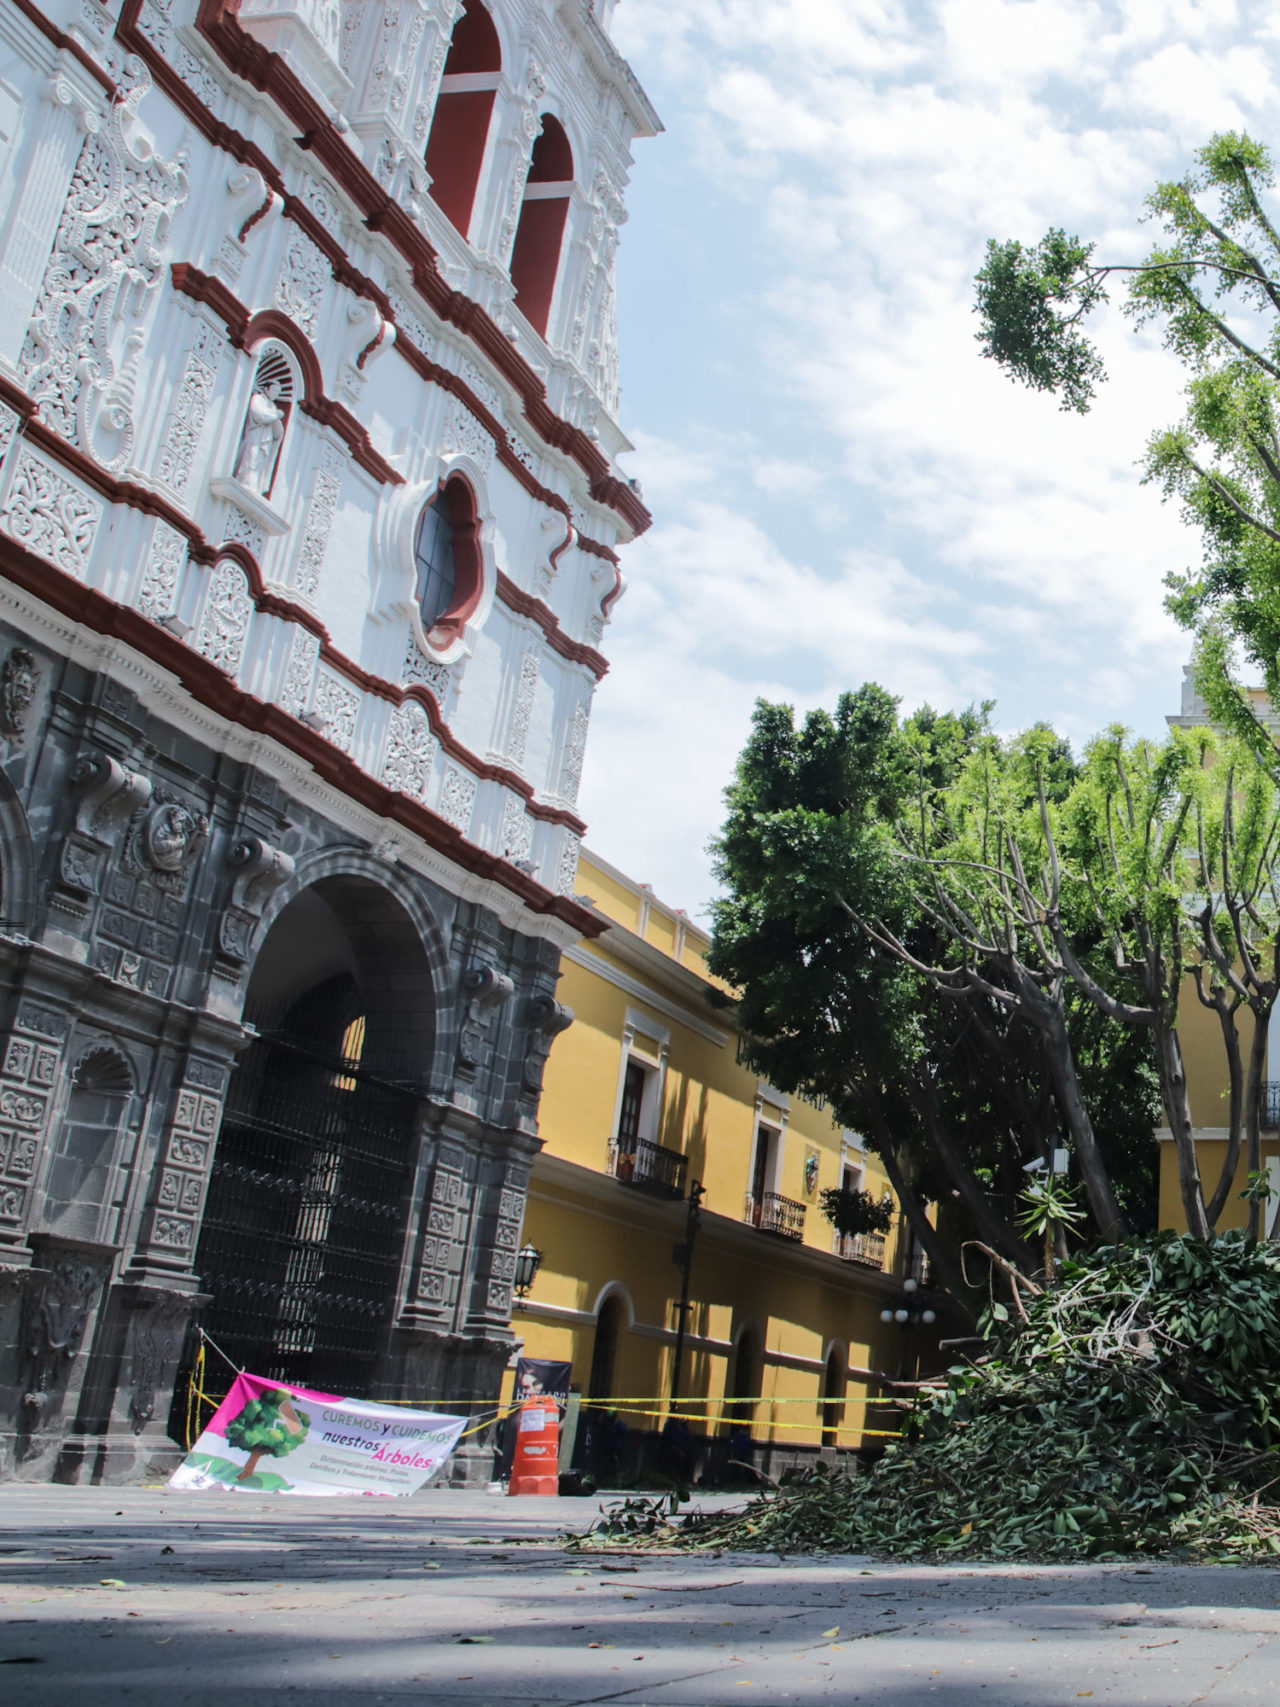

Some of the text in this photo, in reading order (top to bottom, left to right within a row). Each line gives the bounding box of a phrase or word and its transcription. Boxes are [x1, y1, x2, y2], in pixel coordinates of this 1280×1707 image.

[322, 1410, 380, 1432] CUREMOS
[391, 1424, 454, 1445] CUIDEMOS
[322, 1431, 433, 1469] nuestros Árboles
